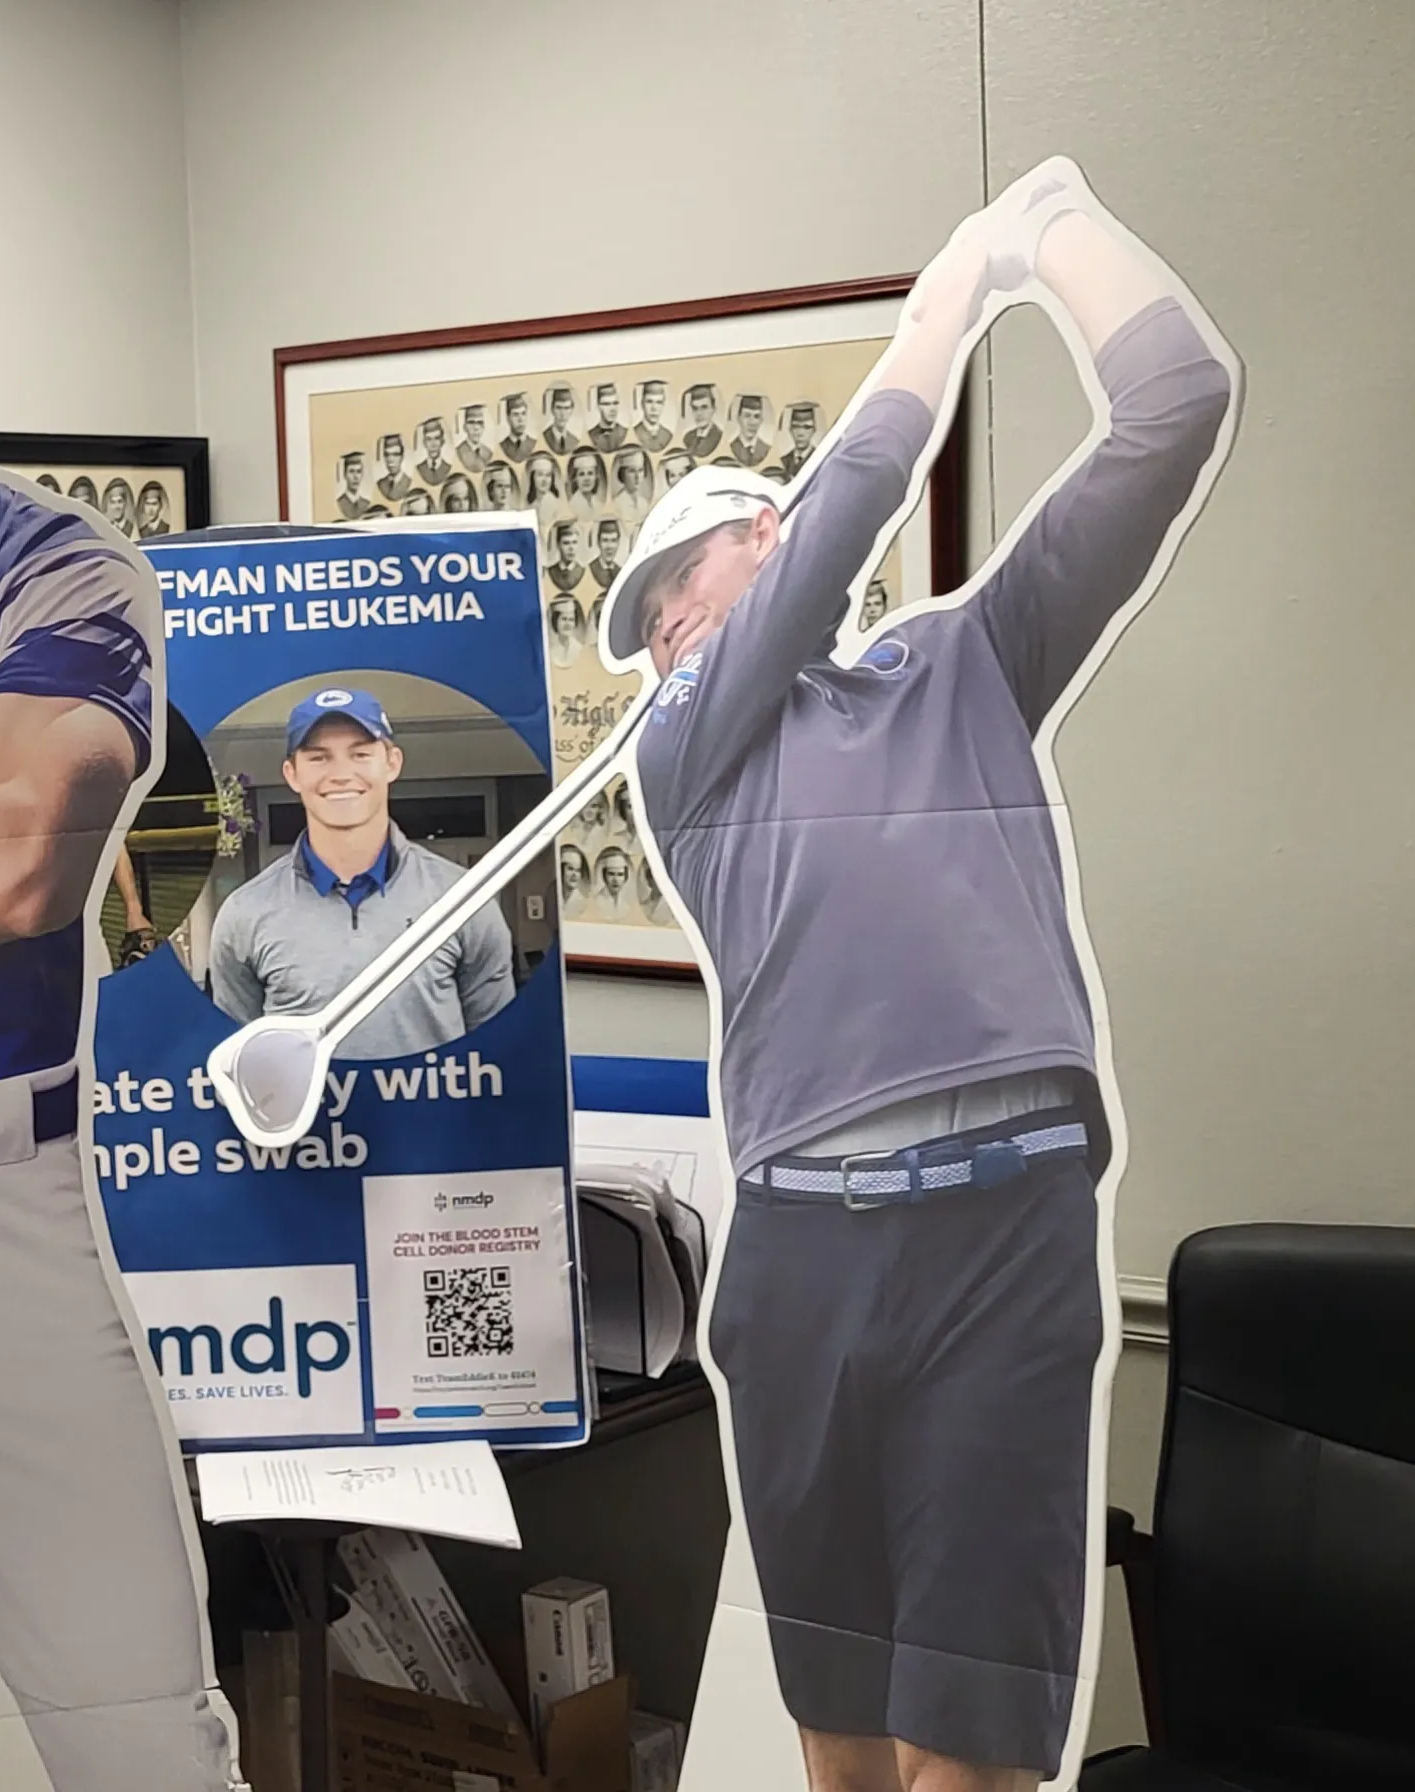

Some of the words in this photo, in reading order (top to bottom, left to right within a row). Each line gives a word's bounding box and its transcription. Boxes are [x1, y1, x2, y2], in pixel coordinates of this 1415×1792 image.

[275, 556, 403, 593] NEEDS
[409, 551, 525, 585] YOUR
[164, 603, 276, 639] FIGHT
[284, 591, 485, 633] LEUKEMIA
[93, 1070, 175, 1115] ate
[372, 1051, 503, 1101] with
[215, 1121, 369, 1173] swab
[452, 1191, 494, 1208] nmdp
[393, 1246, 425, 1258] CELL
[429, 1243, 476, 1256] DONOR
[480, 1240, 542, 1253] REGISTRY
[394, 1232, 425, 1245] JOIN
[428, 1230, 452, 1243] THE
[455, 1228, 501, 1242] BLOOD
[504, 1226, 539, 1239] STEM
[195, 1386, 237, 1400] SAVE
[240, 1384, 289, 1399] LIVES.
